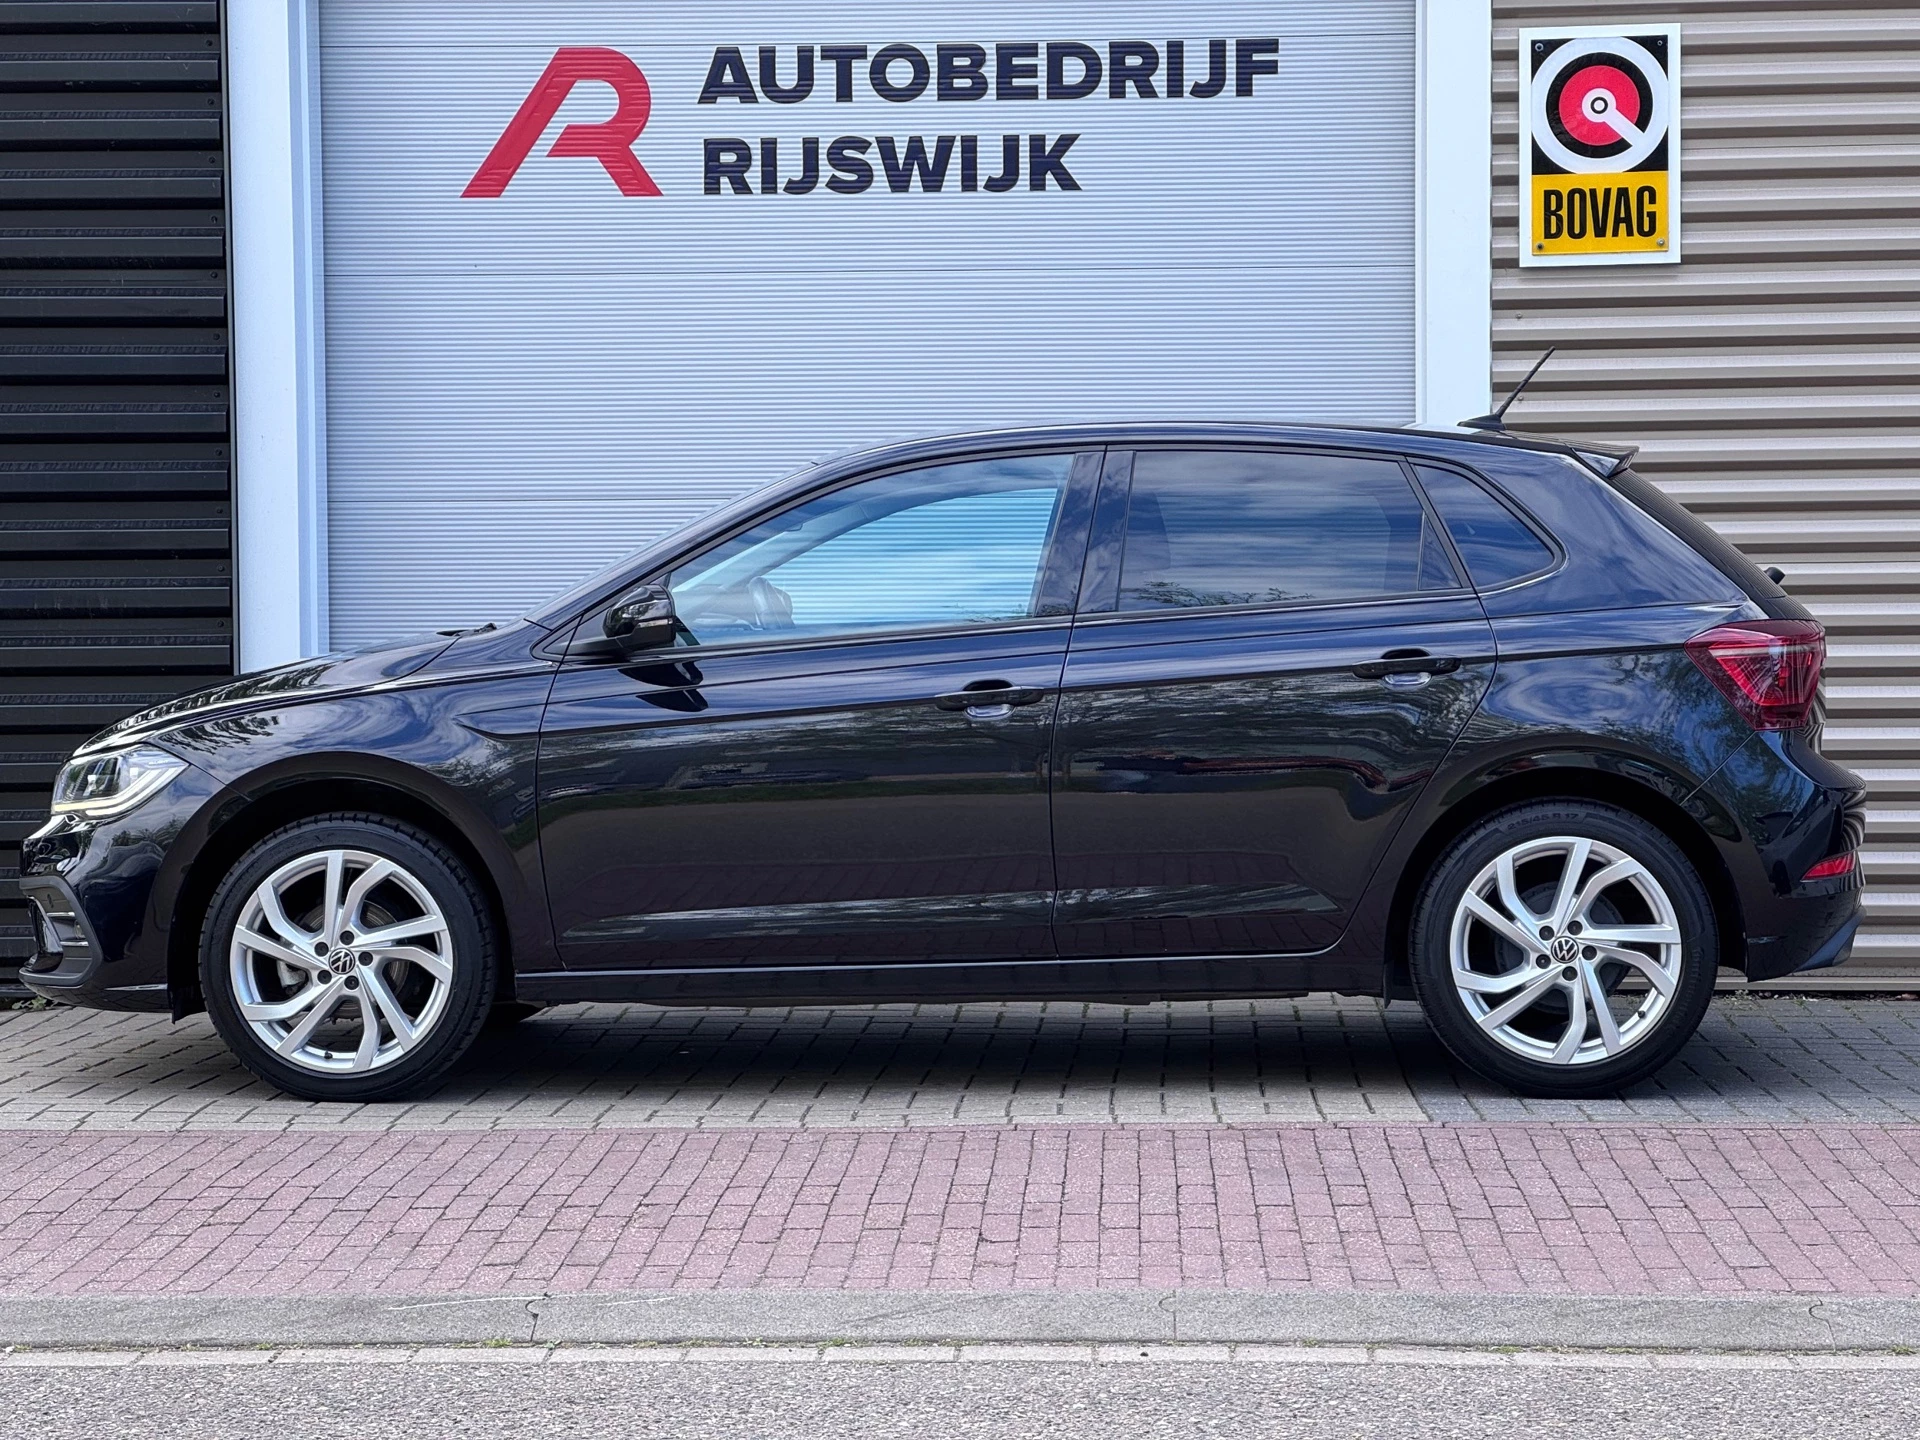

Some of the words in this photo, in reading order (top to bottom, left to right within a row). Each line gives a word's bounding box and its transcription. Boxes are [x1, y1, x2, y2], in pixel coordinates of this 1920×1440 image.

[697, 37, 1280, 105] AUTOBEDRIJF
[701, 133, 1083, 196] RIJSWIJK
[1543, 185, 1657, 240] BOVAG
